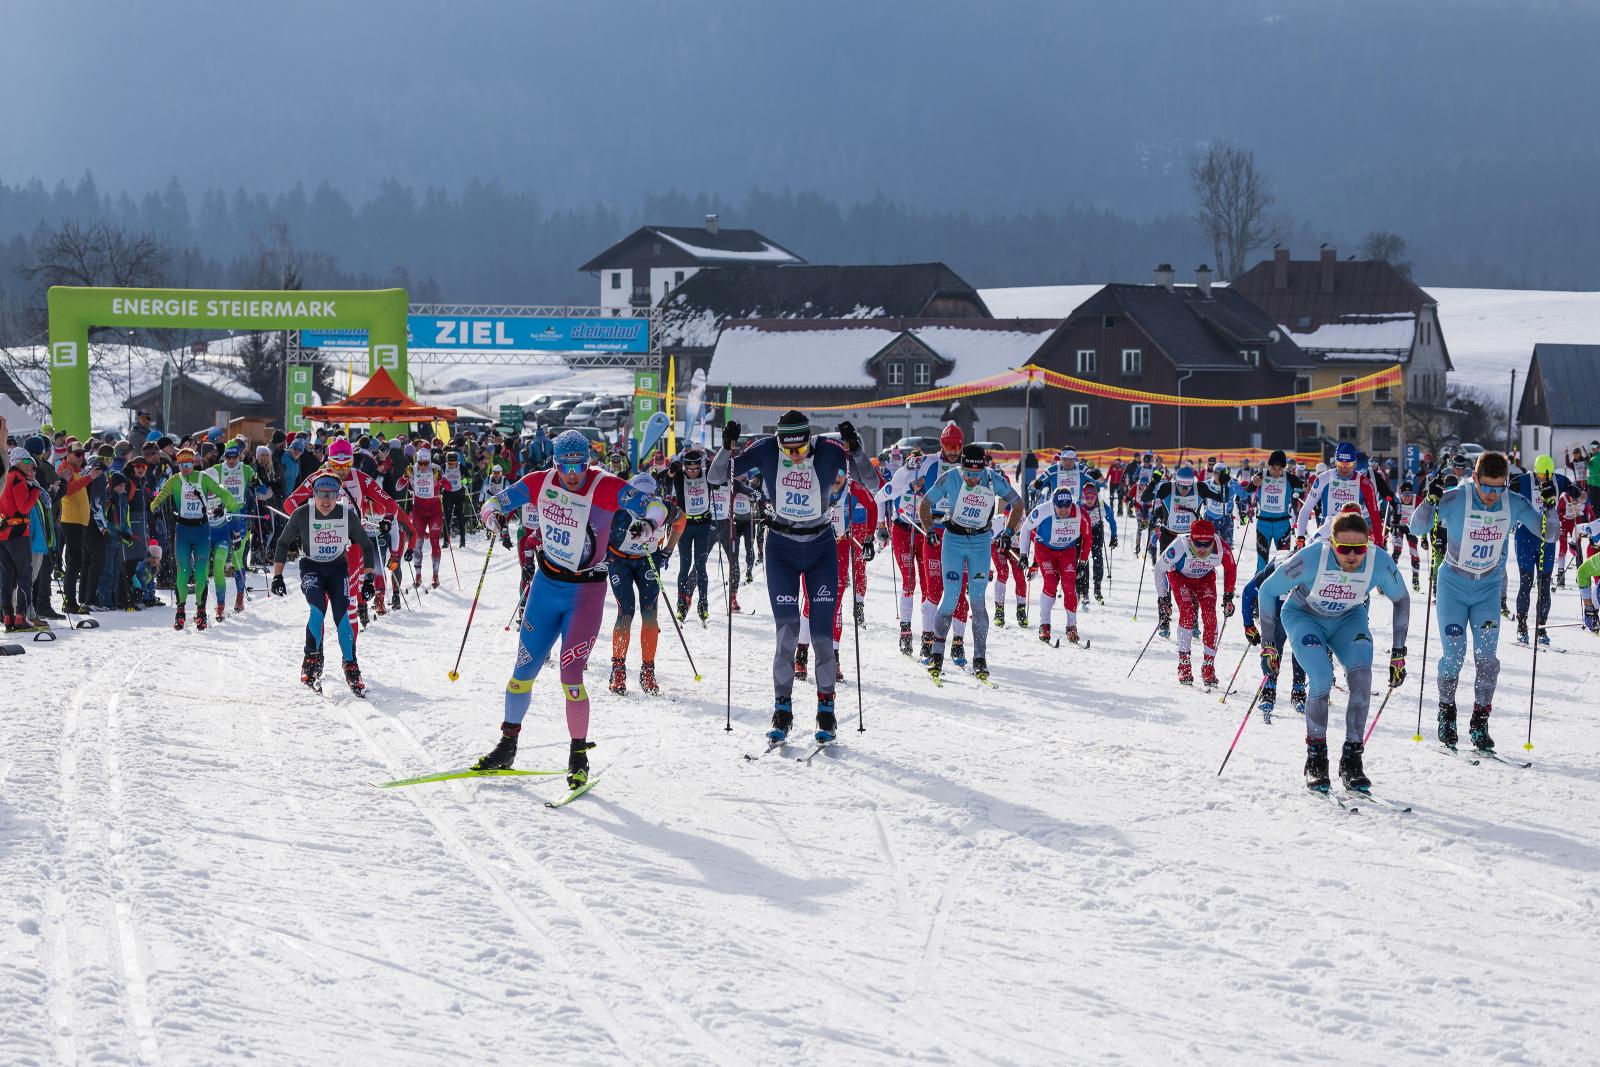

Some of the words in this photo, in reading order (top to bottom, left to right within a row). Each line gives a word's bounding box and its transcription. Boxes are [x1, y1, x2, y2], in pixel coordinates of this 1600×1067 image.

[112, 298, 199, 317] ENERGIE
[206, 299, 337, 318] STEIERMARK
[435, 320, 514, 345] ZIEL
[785, 492, 810, 506] 202
[187, 502, 200, 511] 287
[961, 506, 981, 517] 206
[545, 524, 571, 546] 256
[318, 546, 338, 554] 303
[1471, 545, 1495, 559] 201
[1320, 600, 1348, 610] 205
